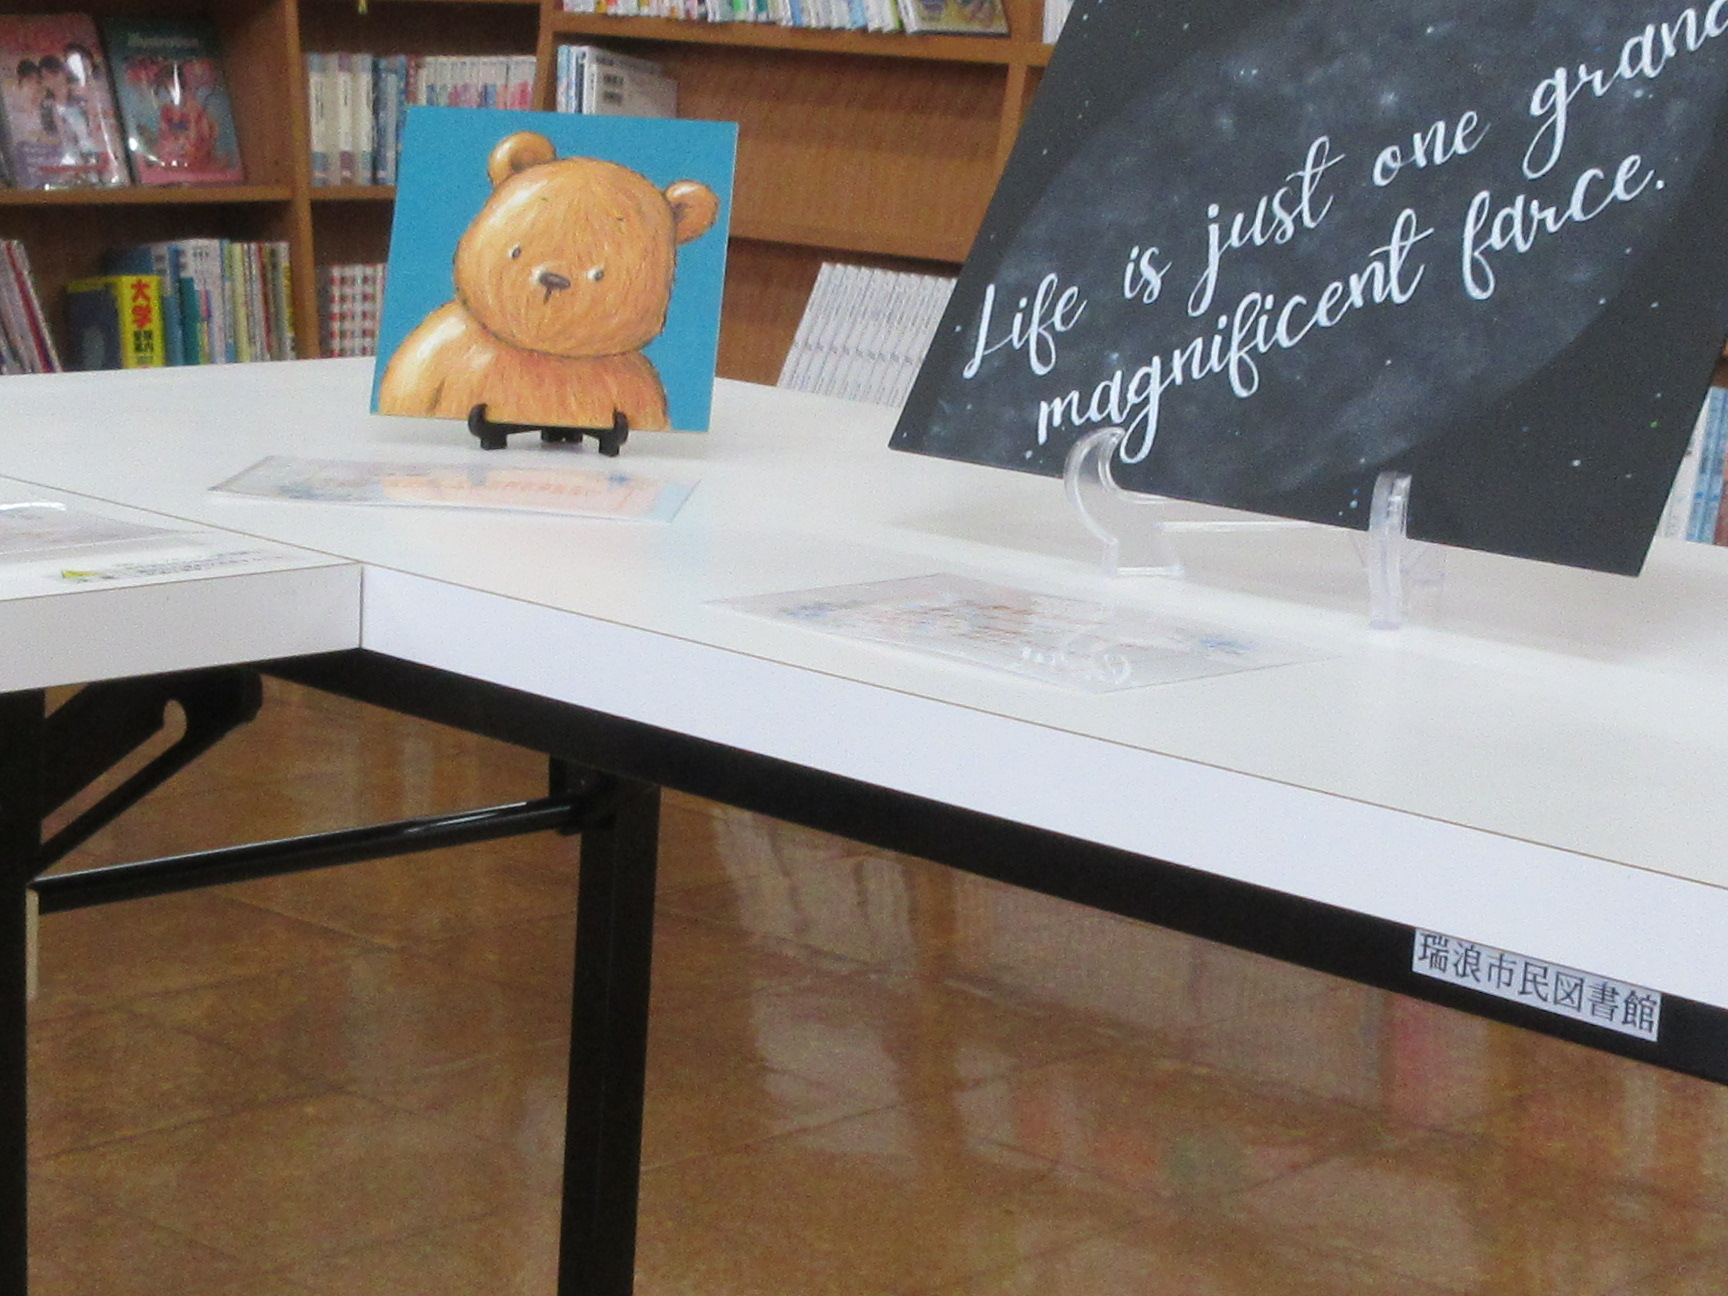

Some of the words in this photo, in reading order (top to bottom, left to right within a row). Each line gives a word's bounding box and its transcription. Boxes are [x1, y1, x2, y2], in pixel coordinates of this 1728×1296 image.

[963, 272, 1086, 379] Life
[1123, 244, 1171, 306] is
[1187, 135, 1346, 318] just
[1372, 110, 1490, 190] one
[1037, 207, 1435, 465] magnificent
[1461, 152, 1665, 301] farce.
[1418, 933, 1657, 1034] 瑞浪市民図書館
